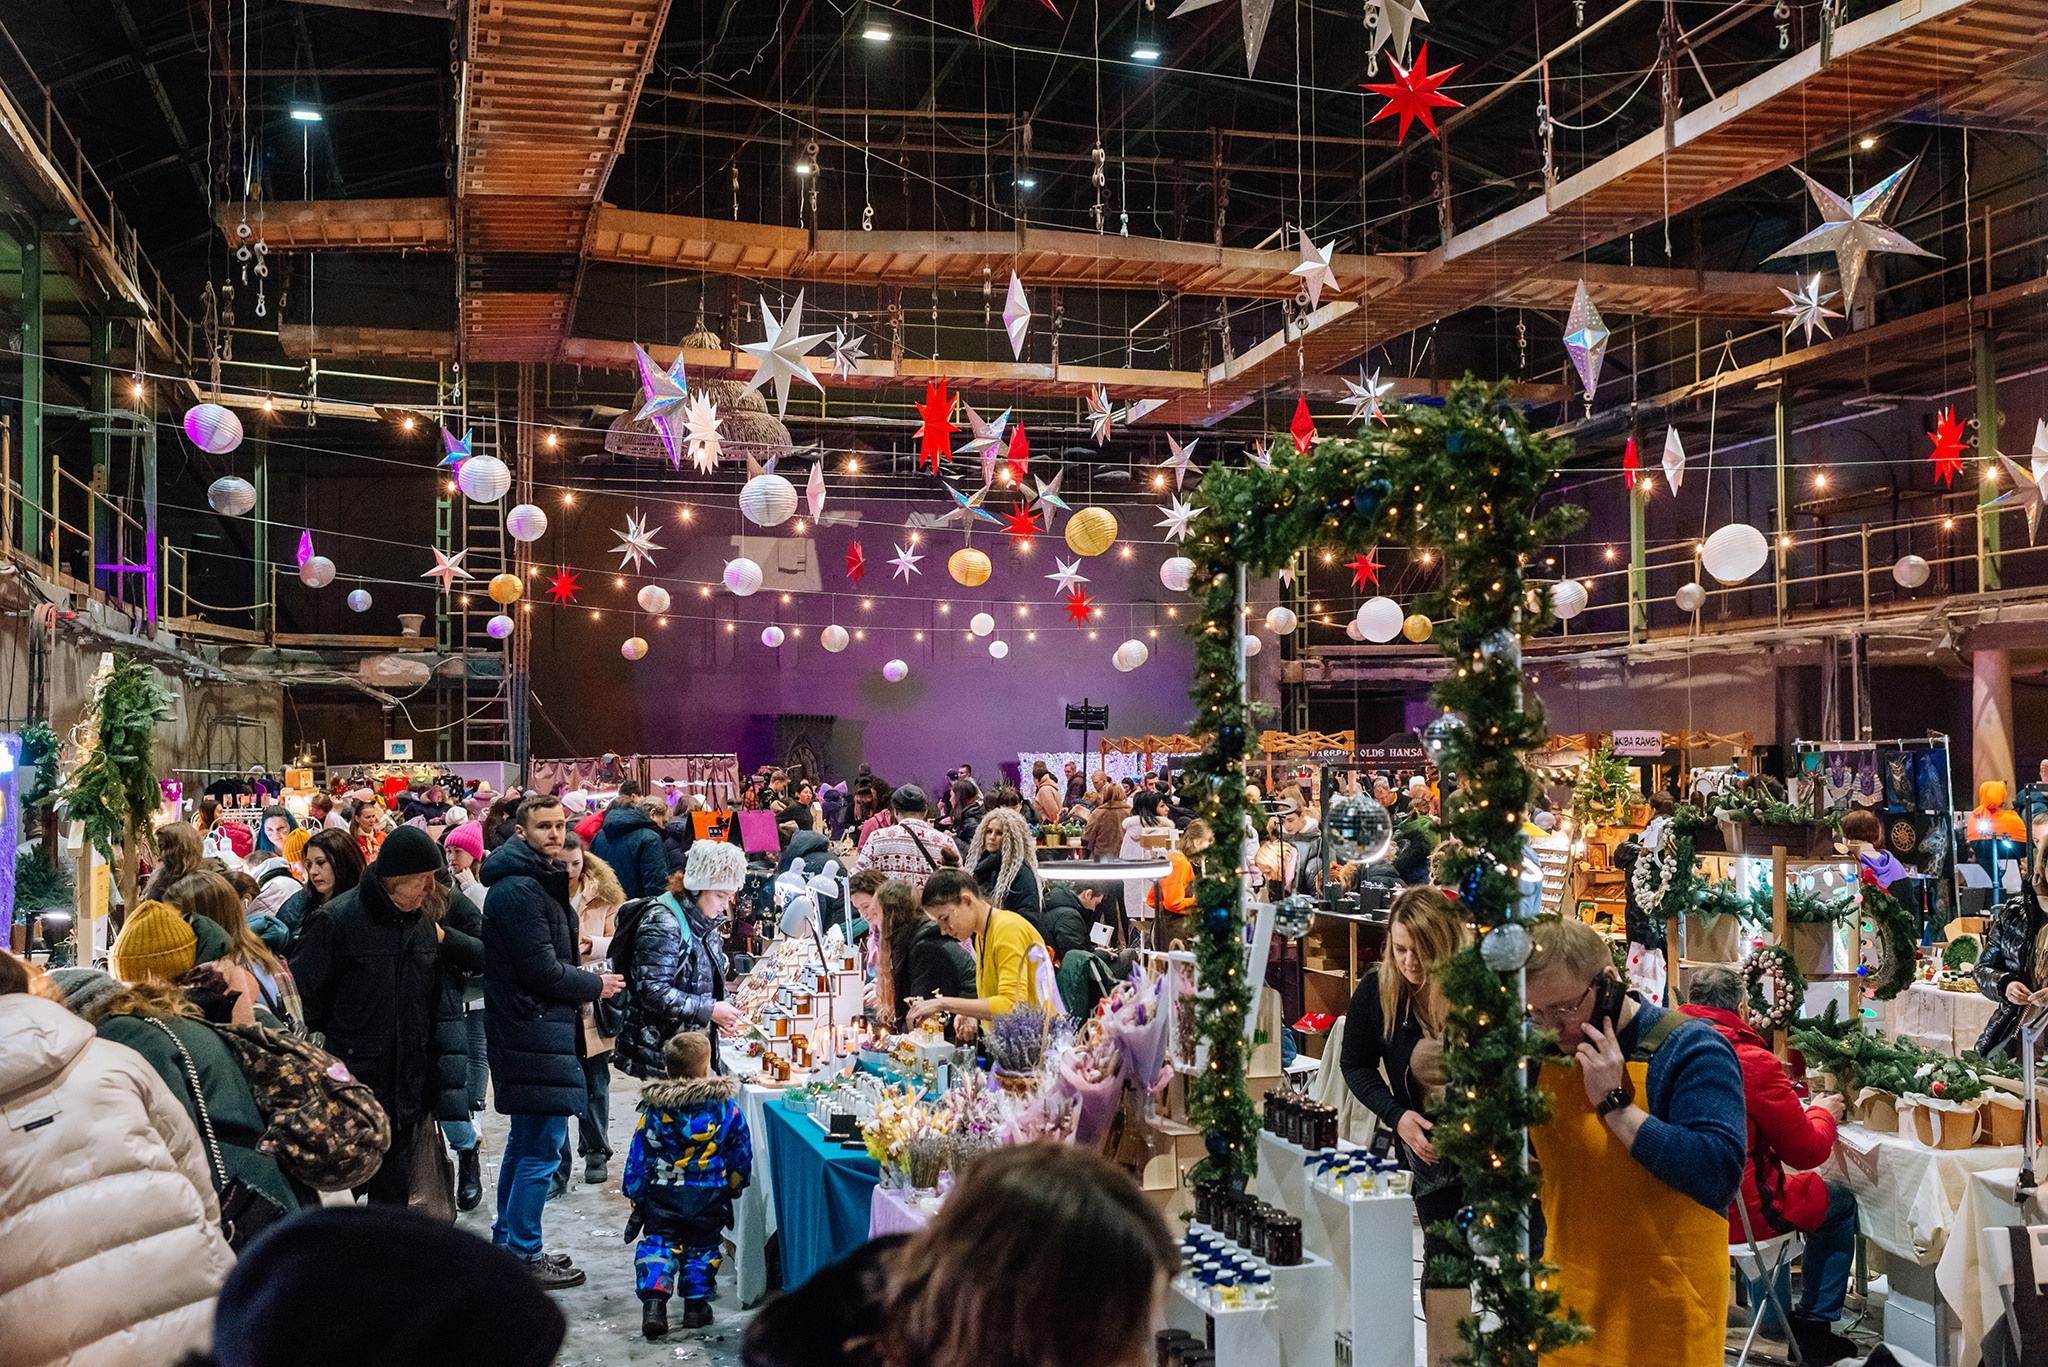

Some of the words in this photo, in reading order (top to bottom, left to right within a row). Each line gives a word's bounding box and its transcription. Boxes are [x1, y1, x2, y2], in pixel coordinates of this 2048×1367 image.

[1635, 736, 1661, 746] RAMEN
[1360, 748, 1385, 758] OLDE
[1389, 748, 1423, 757] HANSA
